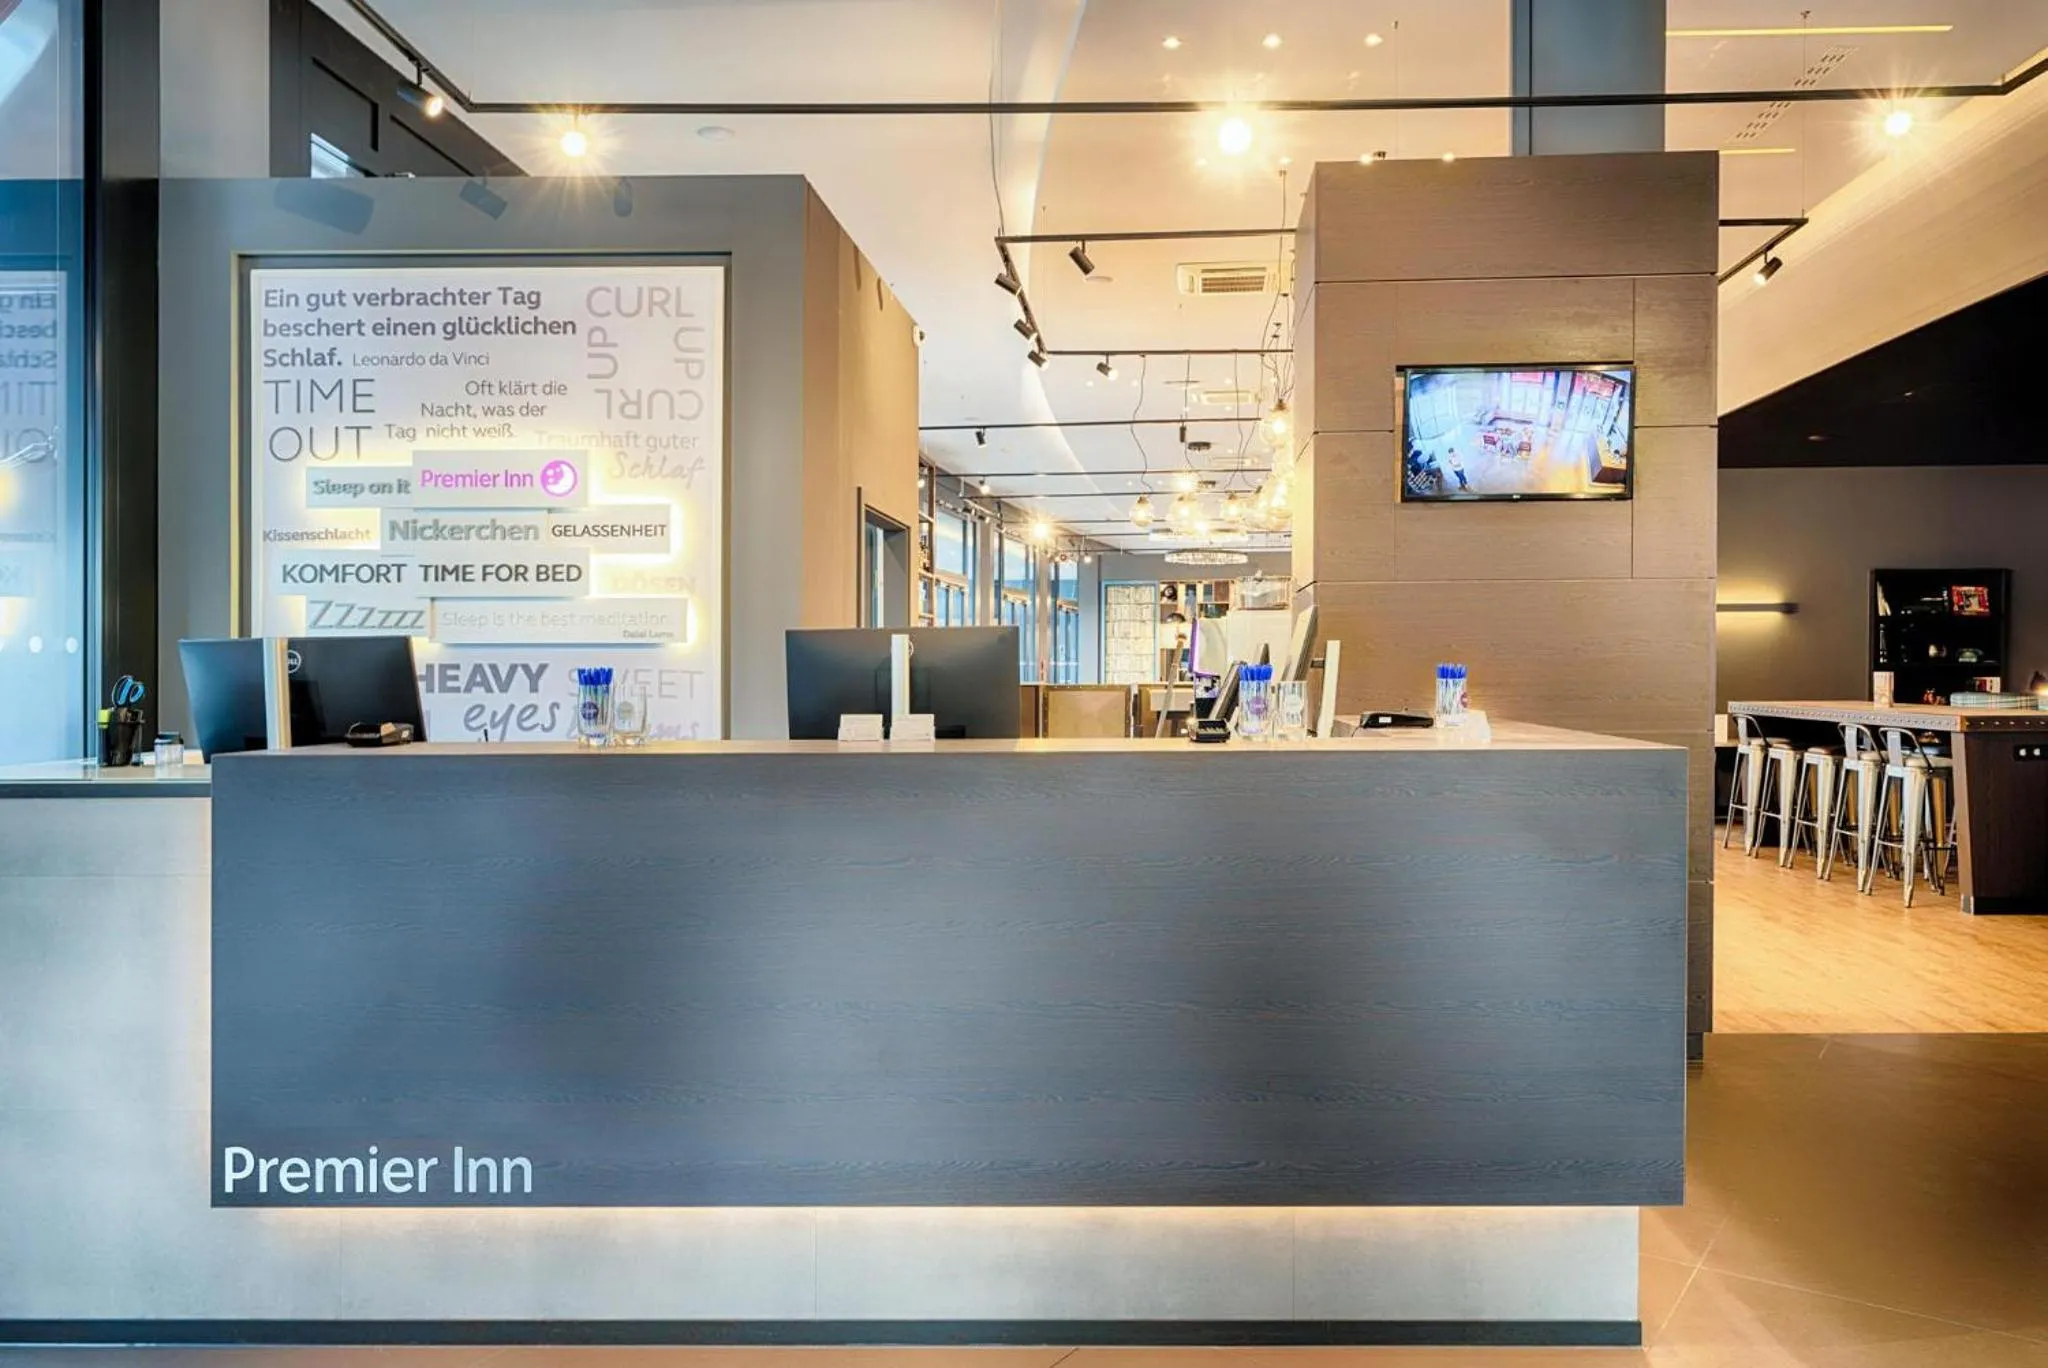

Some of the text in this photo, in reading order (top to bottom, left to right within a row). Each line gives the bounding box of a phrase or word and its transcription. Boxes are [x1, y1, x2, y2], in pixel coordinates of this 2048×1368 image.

[264, 286, 541, 312] Ein gut verbrachter Tag
[586, 286, 695, 318] CURL
[263, 316, 577, 340] beschert einen glücklichen
[263, 347, 489, 367] Schlaf. Leonardo da Vinci
[263, 378, 376, 414] TIME
[465, 379, 568, 396] Oft klärt die
[421, 402, 547, 419] Nacht, was der
[384, 424, 417, 442] Tag
[426, 423, 468, 438] nicht
[534, 430, 699, 452] Traumhaft guter
[269, 426, 372, 462] OUT
[420, 469, 534, 488] Premier Inn
[609, 451, 706, 489] Schlaf
[313, 478, 411, 498] Sleep on it
[263, 527, 372, 543] Kissenschlacht
[388, 519, 540, 541] Nickerchen
[551, 524, 667, 538] GELASSENHEIT
[282, 563, 407, 584] KOMFORT
[418, 564, 582, 583] TIME FOR BED
[442, 611, 488, 630] Sleep
[493, 611, 504, 626] is
[510, 611, 536, 626] the
[541, 611, 577, 627] best
[417, 663, 549, 694] HEAVY
[464, 702, 560, 742] eyes
[224, 1146, 532, 1193] Premier Inn
